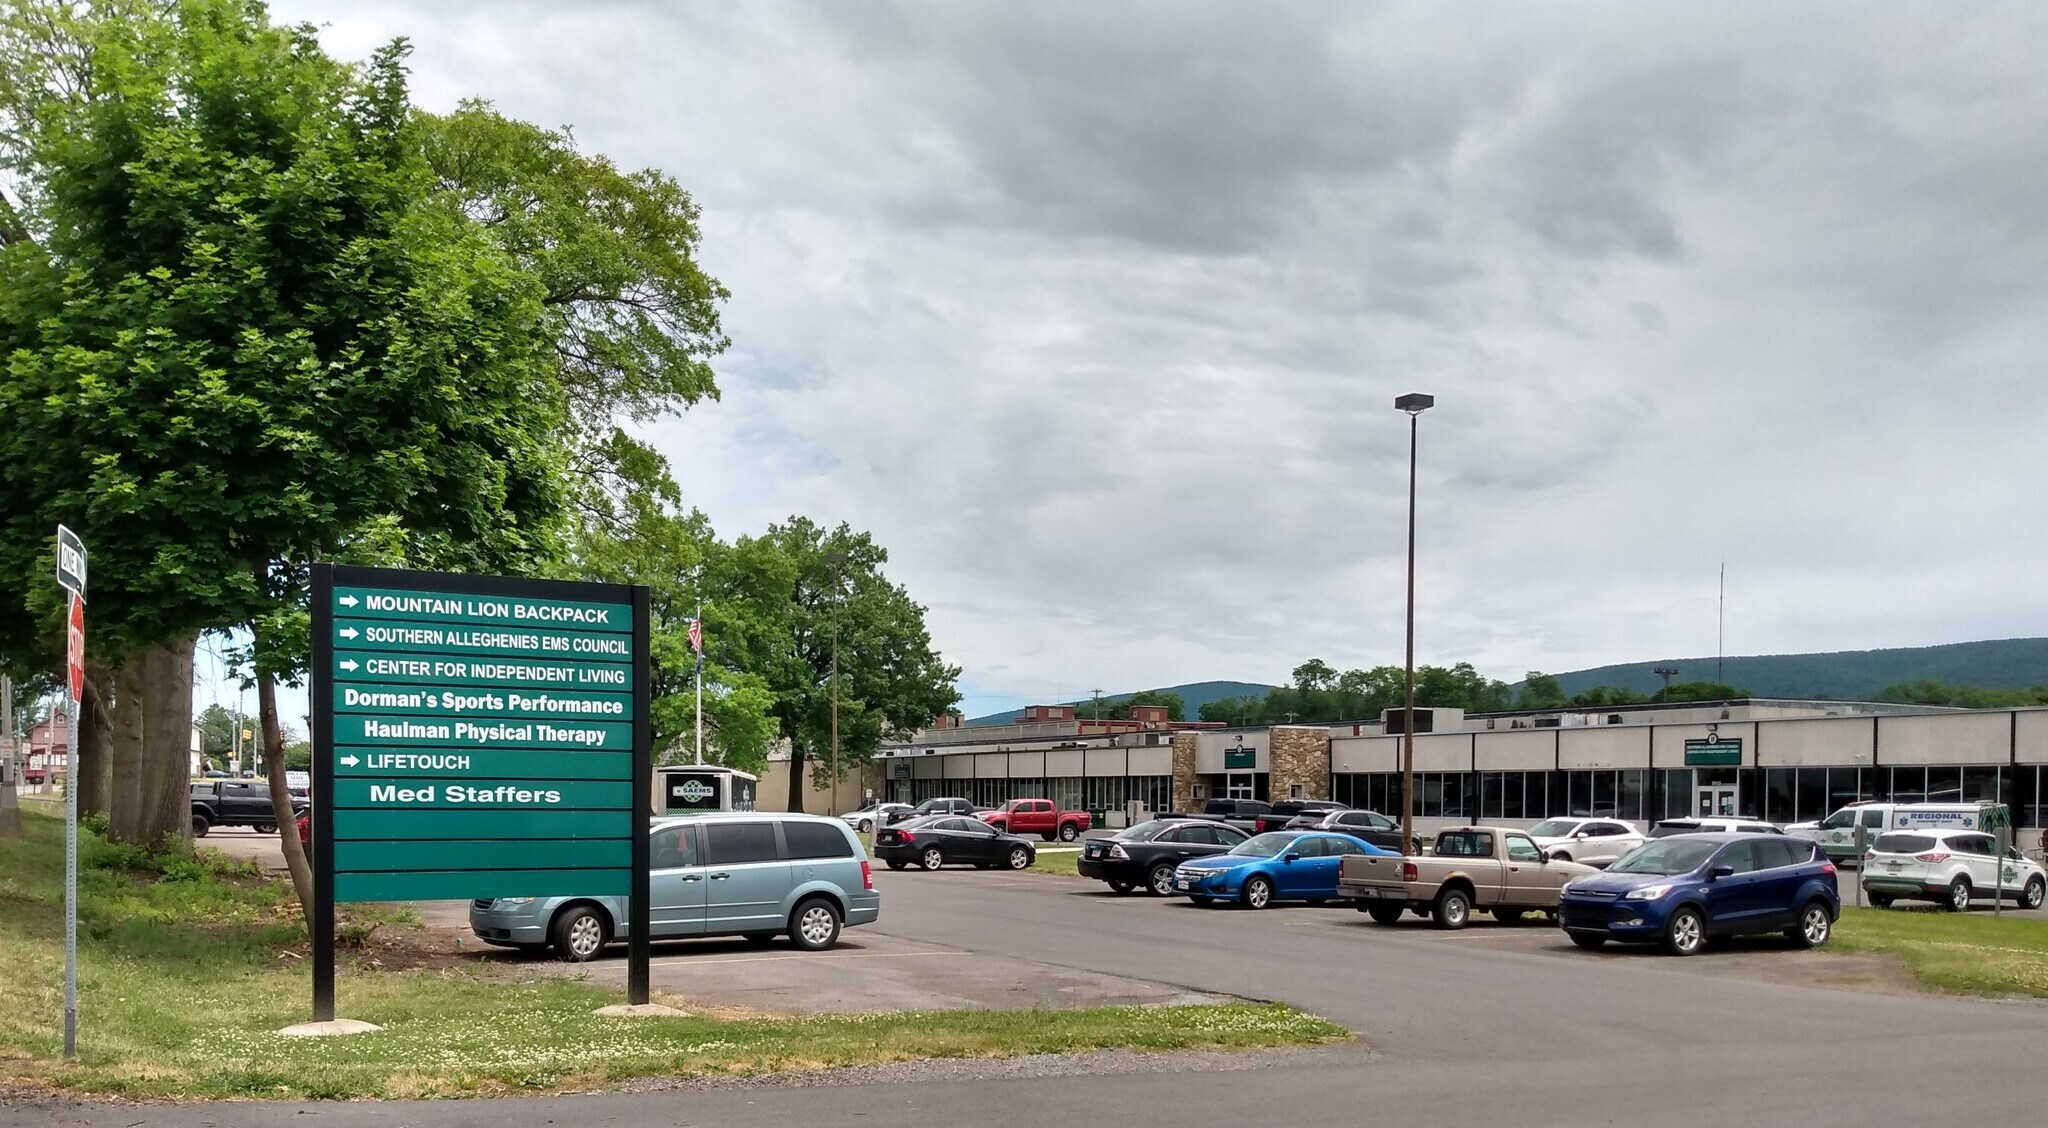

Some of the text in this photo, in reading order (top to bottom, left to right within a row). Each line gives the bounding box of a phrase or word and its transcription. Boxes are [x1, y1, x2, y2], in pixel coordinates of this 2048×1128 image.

[63, 546, 75, 573] ONE
[367, 596, 608, 623] MOUNTAIN LION BACKPACK
[367, 627, 628, 654] SOUTHERN ALLEGHENIES EMS COUNCIL
[367, 659, 624, 683] CENTER FOR INDEPENDENT LIVING
[345, 689, 623, 713] Dorman's Sports Performance
[365, 721, 606, 746] Haulman Physical Therapy
[368, 755, 469, 769] LIFETOUCH
[371, 786, 560, 802] Med Staffers
